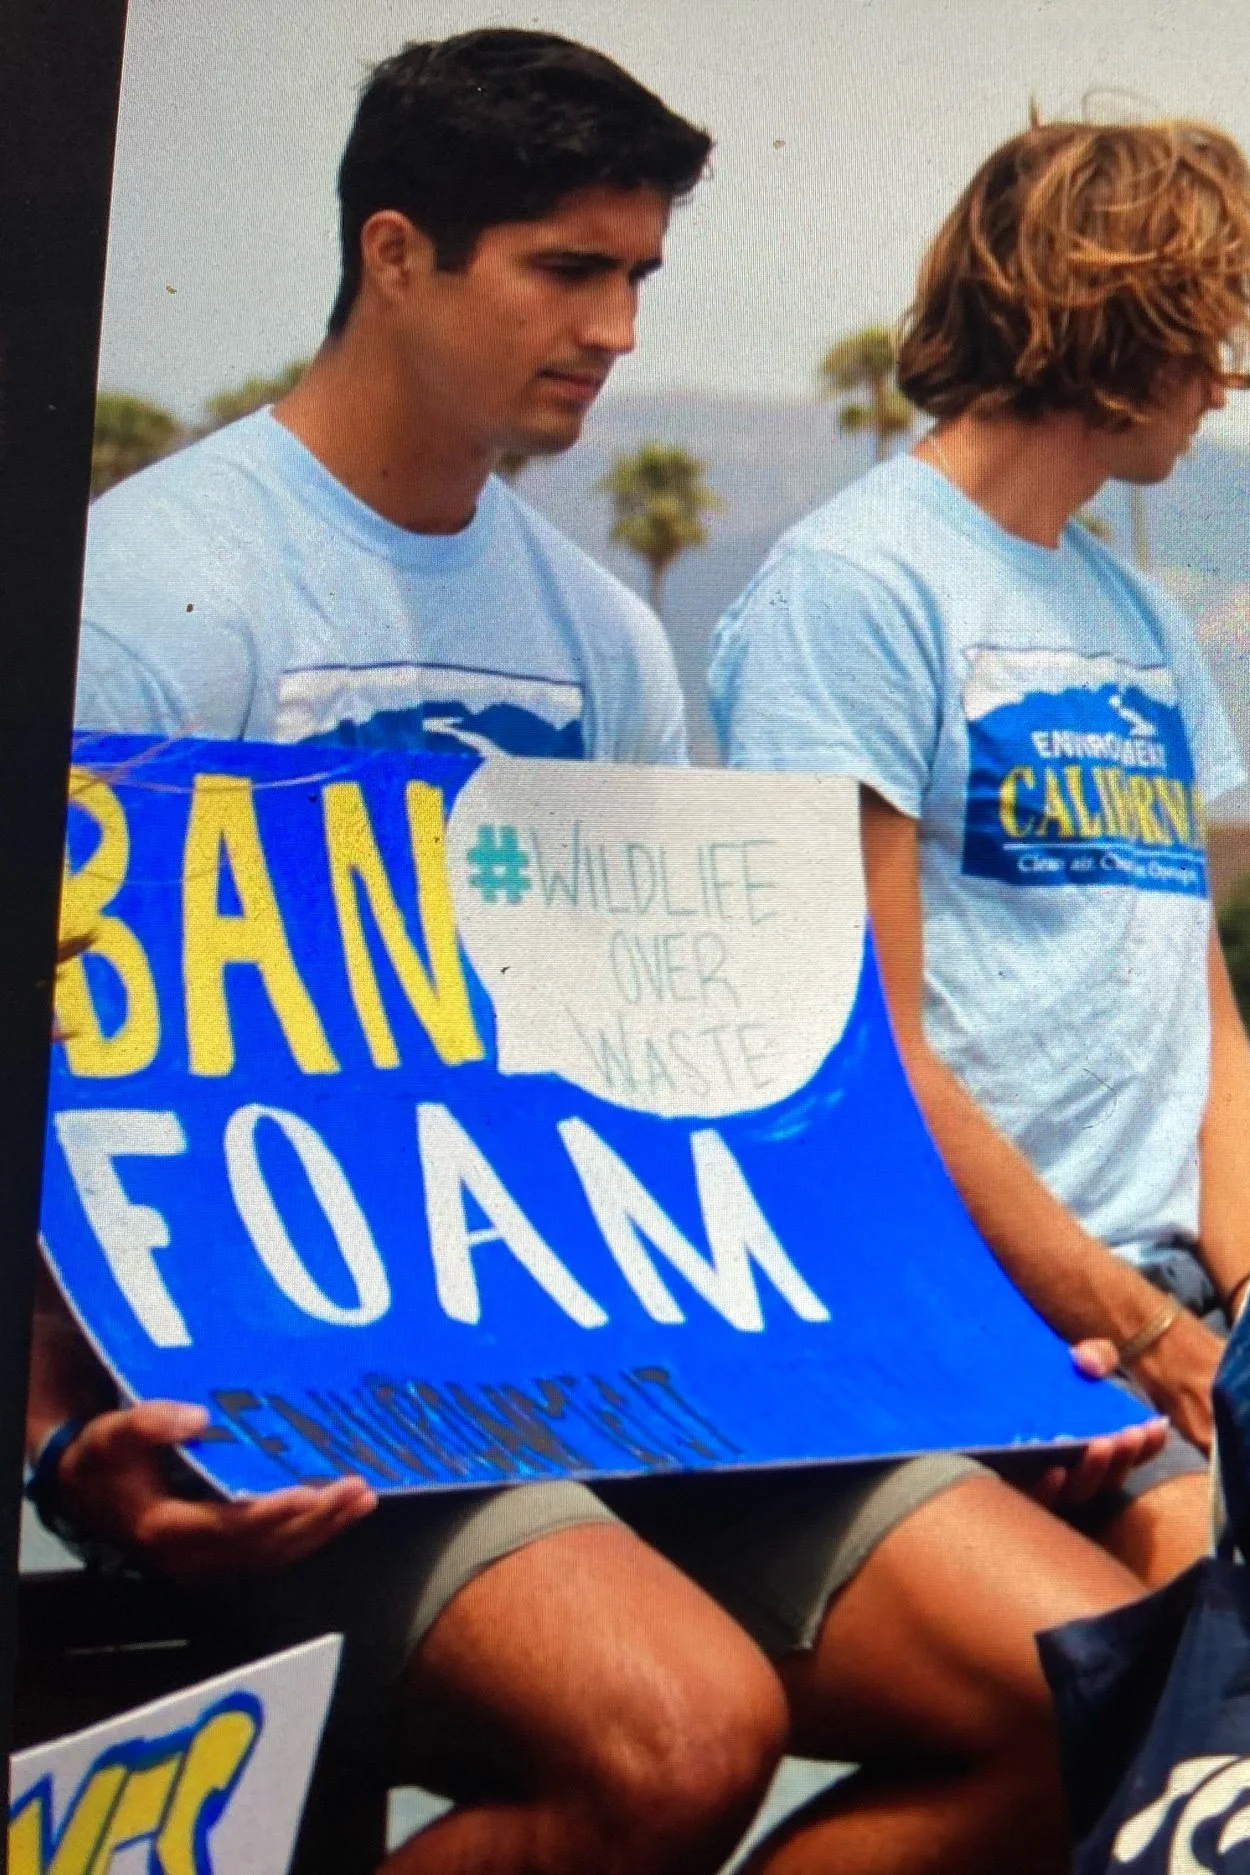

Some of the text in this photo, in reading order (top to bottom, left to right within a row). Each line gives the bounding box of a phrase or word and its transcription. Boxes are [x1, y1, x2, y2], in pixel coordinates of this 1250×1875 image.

[55, 764, 487, 1078] BAN
[466, 820, 777, 925] #WILDLIFE
[607, 928, 741, 1004] OVER
[564, 1003, 778, 1096] WASTE
[54, 1102, 832, 1348] FOAM
